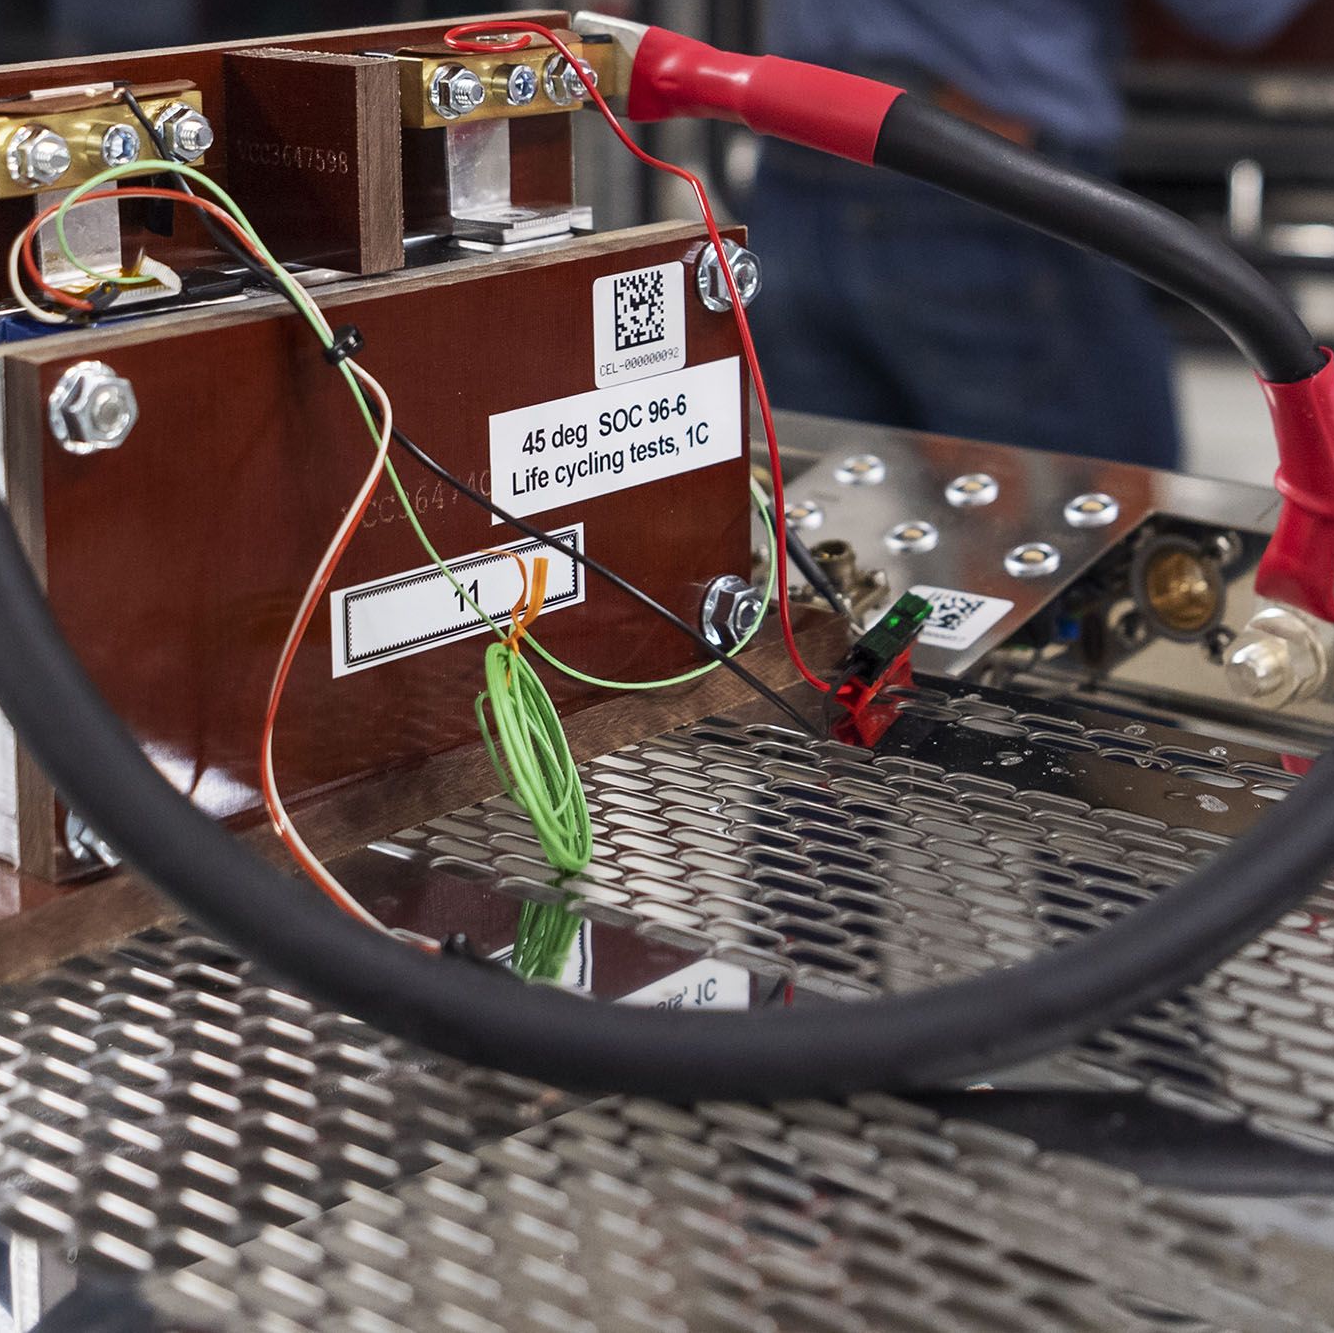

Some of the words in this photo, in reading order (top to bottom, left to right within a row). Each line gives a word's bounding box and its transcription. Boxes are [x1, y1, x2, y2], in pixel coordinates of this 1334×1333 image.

[522, 428, 546, 456] 45
[552, 423, 588, 448] deg
[598, 404, 644, 437] SOC
[649, 393, 687, 423] 96-6
[512, 466, 549, 496] Life
[555, 451, 624, 488] cycling
[630, 439, 680, 465] tests,
[686, 421, 709, 447] 1C
[454, 578, 479, 612] 11
